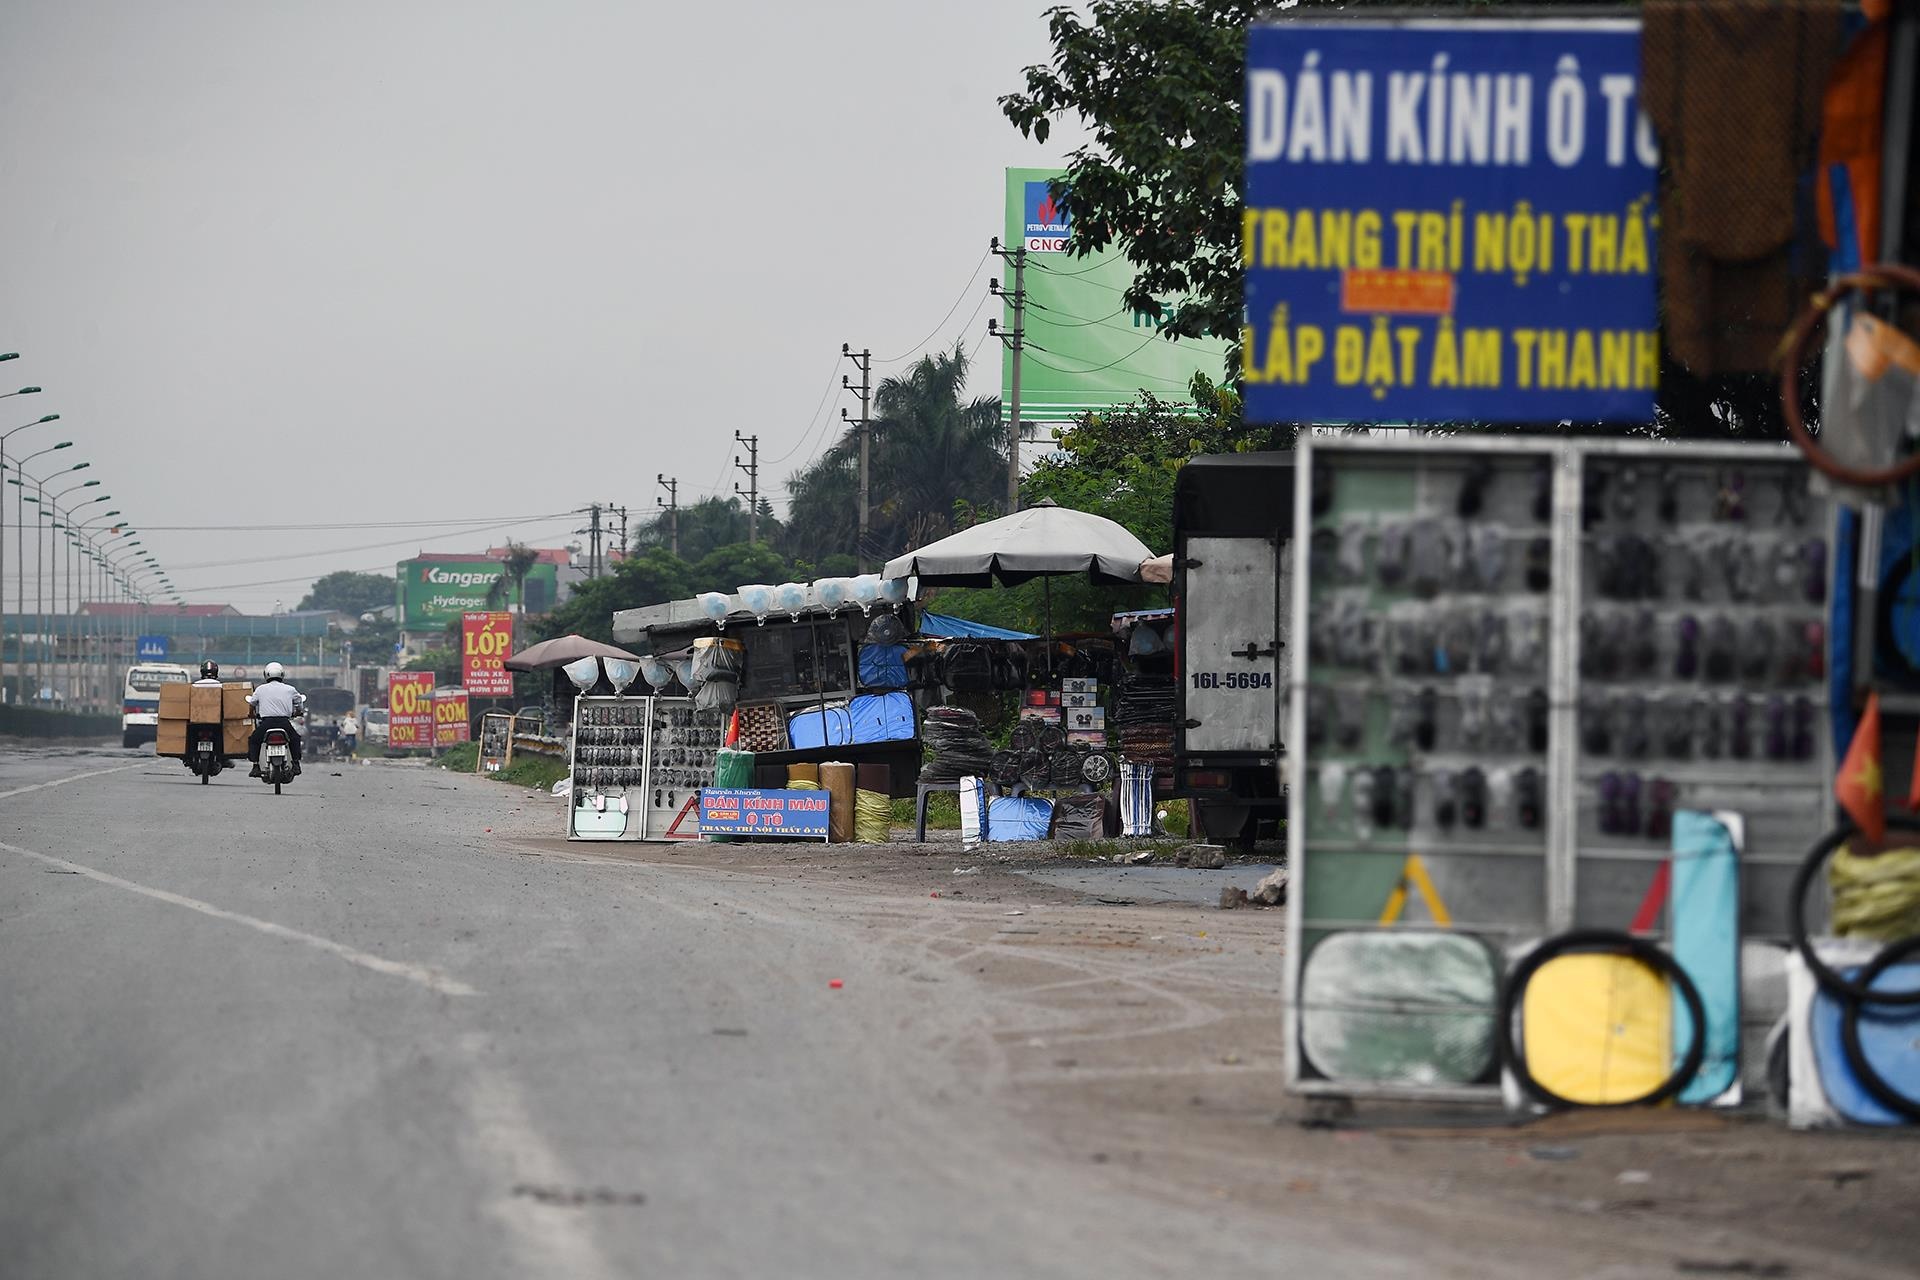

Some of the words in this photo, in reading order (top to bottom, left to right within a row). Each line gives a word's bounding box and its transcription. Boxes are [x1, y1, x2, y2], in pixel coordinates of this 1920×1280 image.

[1247, 50, 1373, 165] DÁN
[1386, 52, 1531, 167] KÍNH
[1547, 54, 1586, 168] Ô
[1243, 207, 1383, 270] TRANG
[1393, 197, 1464, 272] TRÍ
[1474, 200, 1554, 287] NỘI
[1564, 192, 1660, 275] THẤ
[1429, 318, 1501, 389] ÂM
[1513, 328, 1660, 391] THANH
[465, 621, 510, 656] LỐP
[471, 657, 481, 669] Ô
[484, 657, 501, 669] TÔ
[1192, 672, 1272, 689] 16L-5694
[391, 681, 432, 714] CƠM
[436, 702, 467, 722] CƠM
[743, 797, 784, 811] KÍNH
[746, 811, 758, 826] Ô
[762, 811, 783, 826] TÔ
[755, 825, 773, 834] NỘI
[776, 825, 802, 834] THẤT
[804, 825, 811, 834] Ô
[813, 825, 827, 834] TÔ
